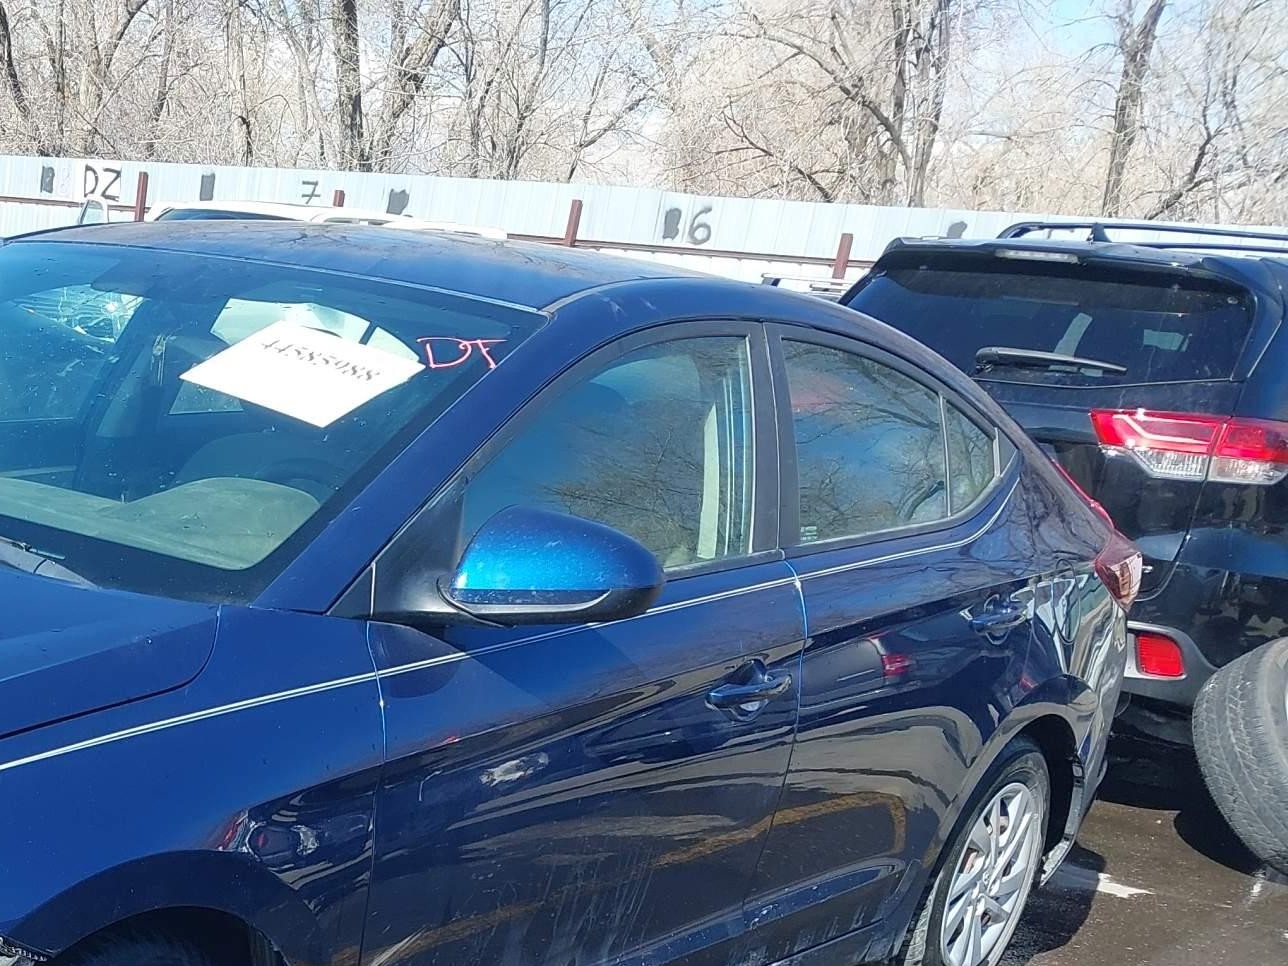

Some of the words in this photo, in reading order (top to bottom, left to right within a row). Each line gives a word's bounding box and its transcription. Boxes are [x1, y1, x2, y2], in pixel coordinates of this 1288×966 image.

[83, 163, 122, 202] DZ
[301, 180, 321, 205] 7
[688, 207, 713, 246] 6
